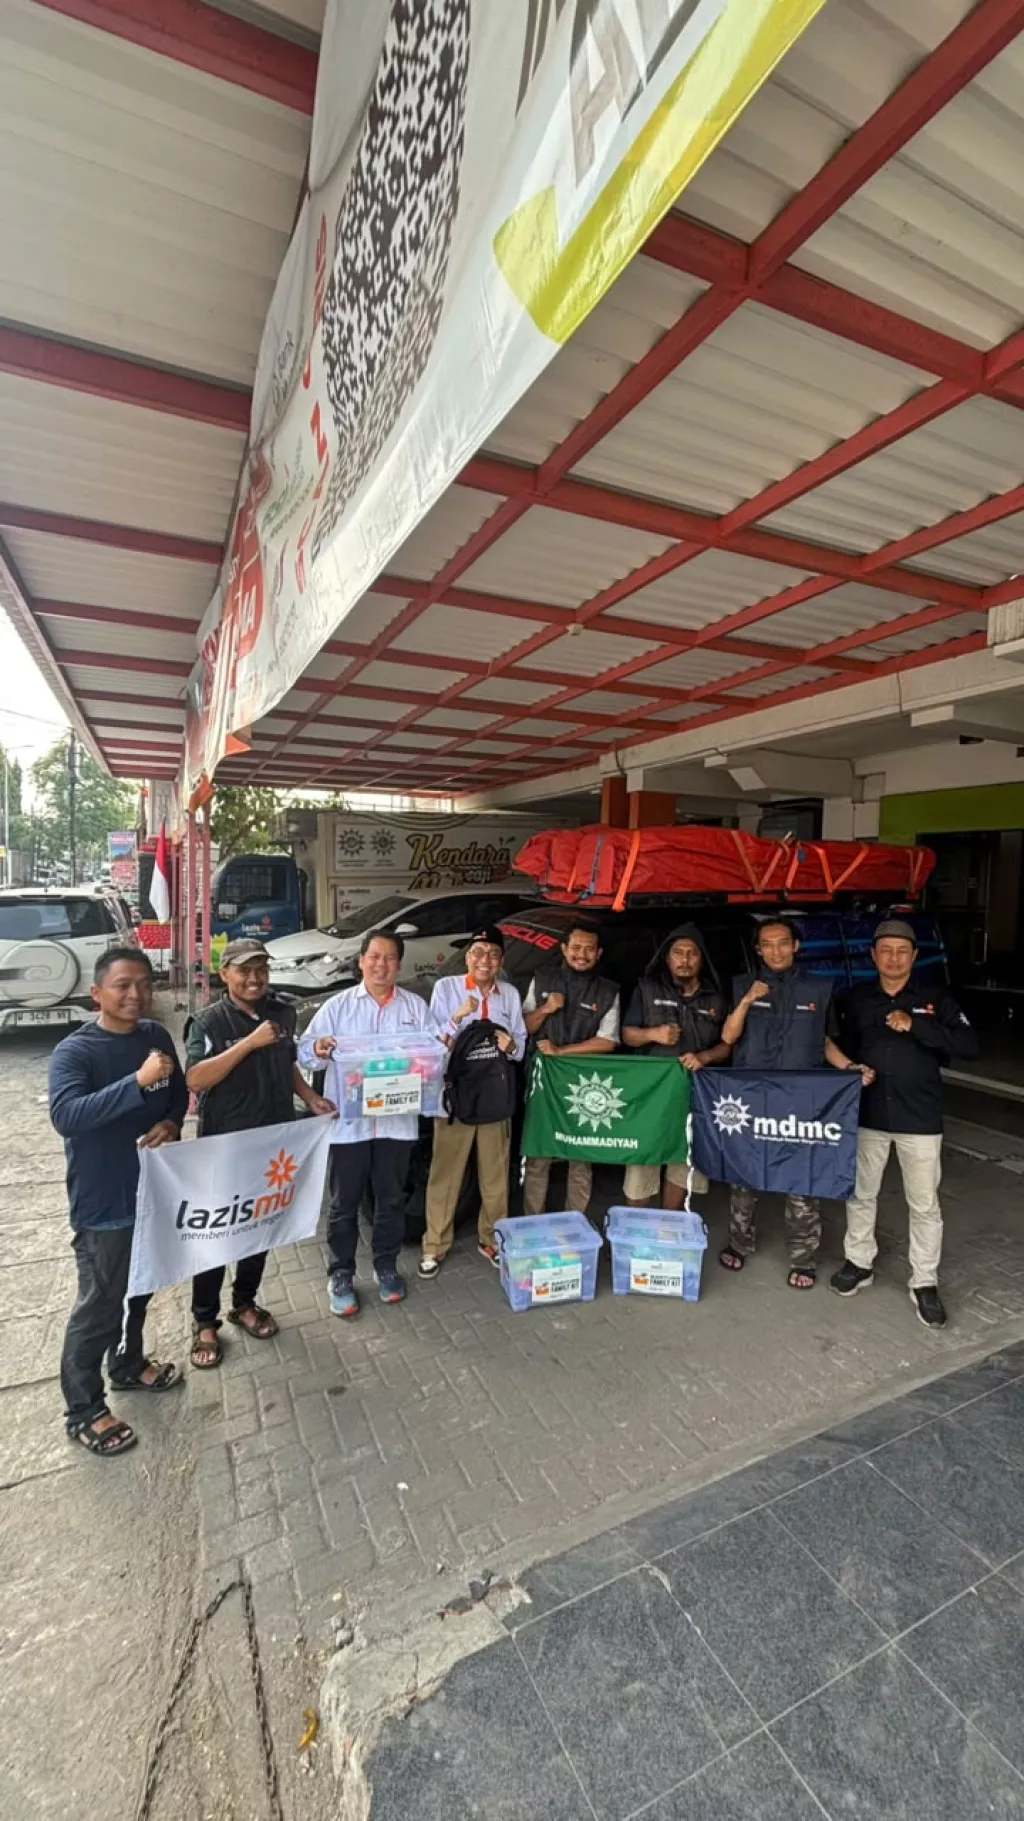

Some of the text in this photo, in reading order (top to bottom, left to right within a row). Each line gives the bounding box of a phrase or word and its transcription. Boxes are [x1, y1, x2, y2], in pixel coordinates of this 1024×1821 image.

[753, 1114, 842, 1141] mdmc
[554, 1131, 638, 1149] MUHAMMADIYAH
[175, 1184, 296, 1230] lazismu
[180, 1229, 230, 1241] memberi
